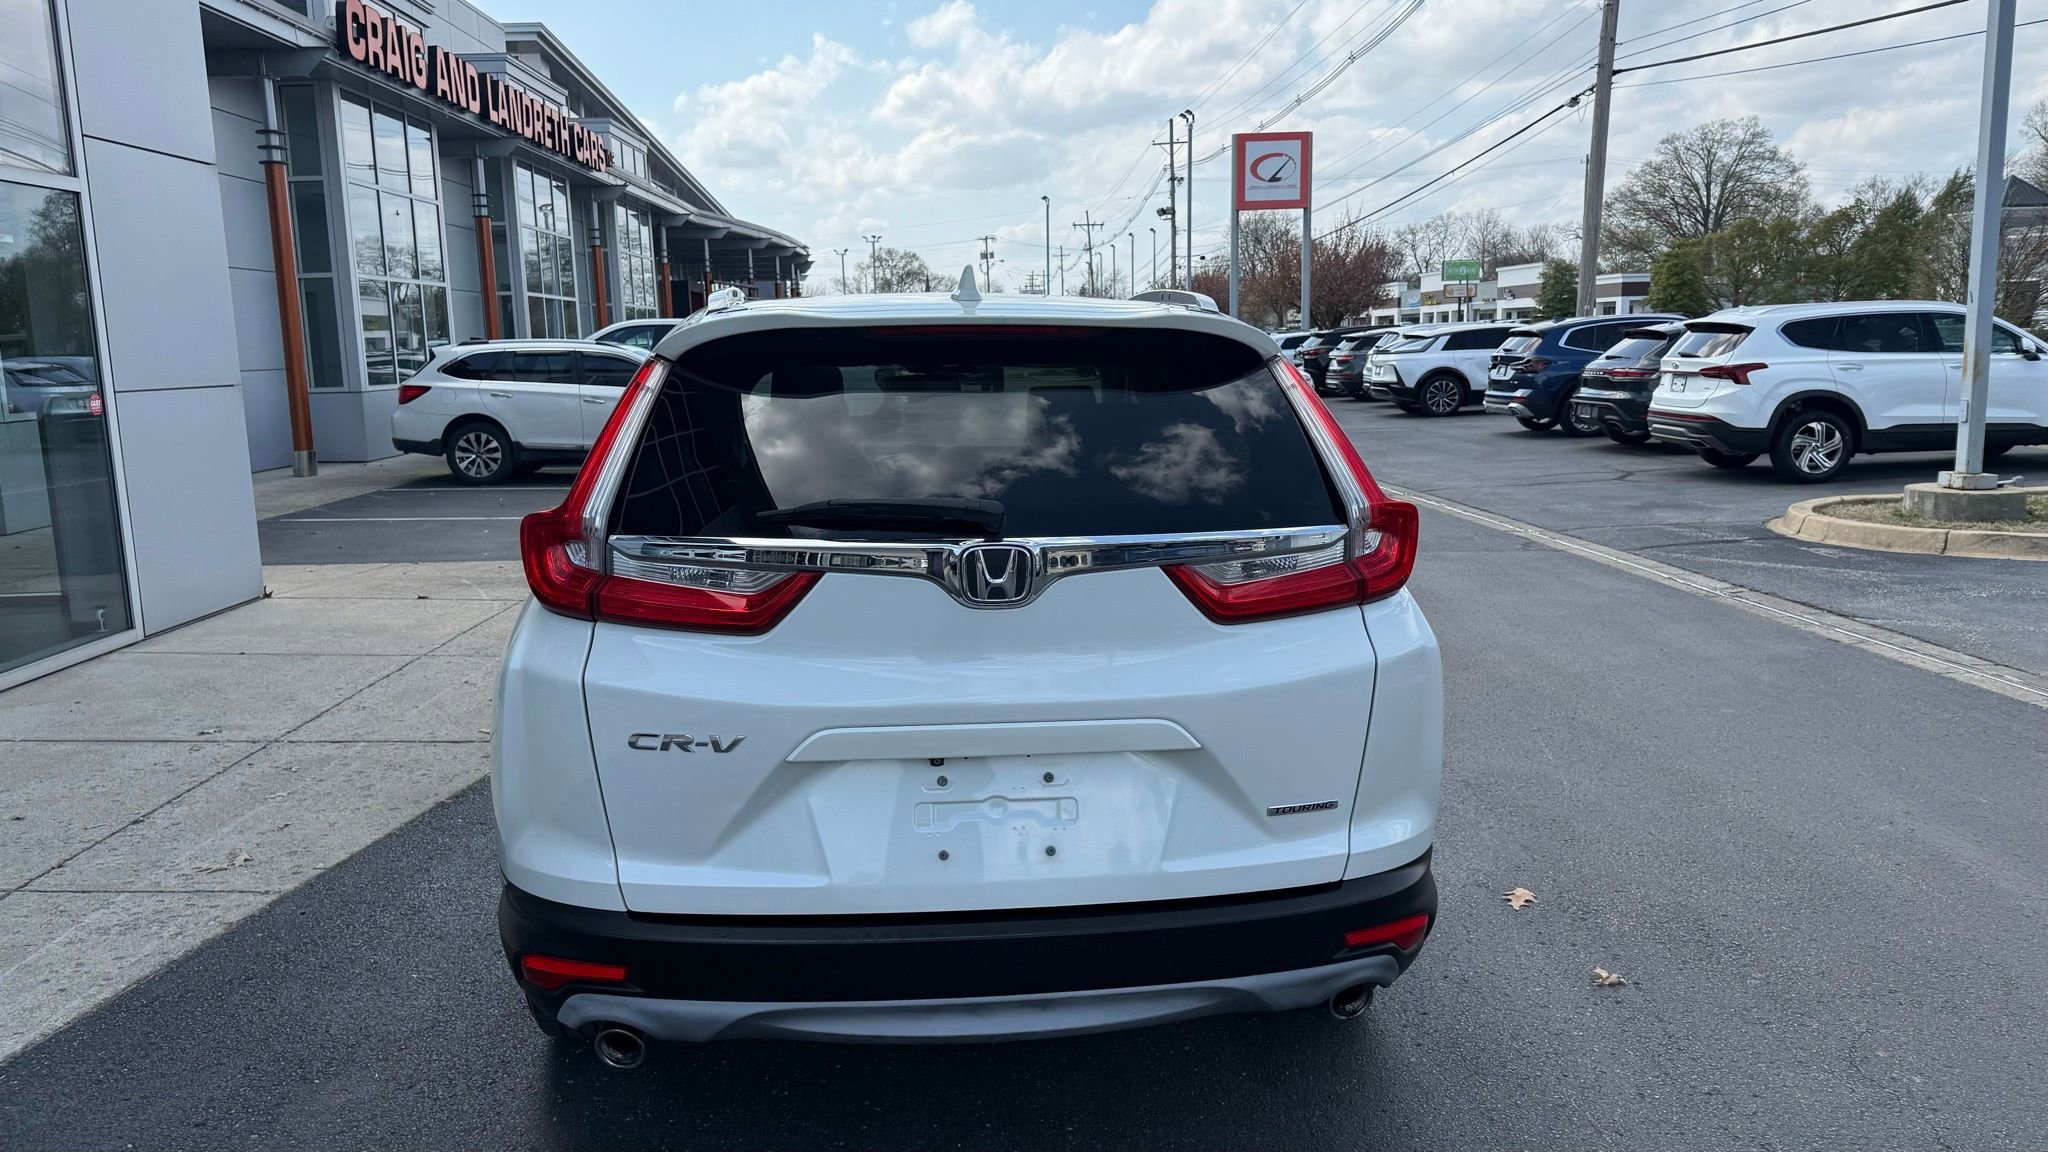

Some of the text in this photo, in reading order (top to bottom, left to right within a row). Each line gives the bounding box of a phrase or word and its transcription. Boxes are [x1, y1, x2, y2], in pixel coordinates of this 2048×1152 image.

[344, 0, 606, 173] CRAIG AND LANDRETH CARS
[627, 732, 748, 754] CR-V
[1272, 801, 1336, 816] TOURING
